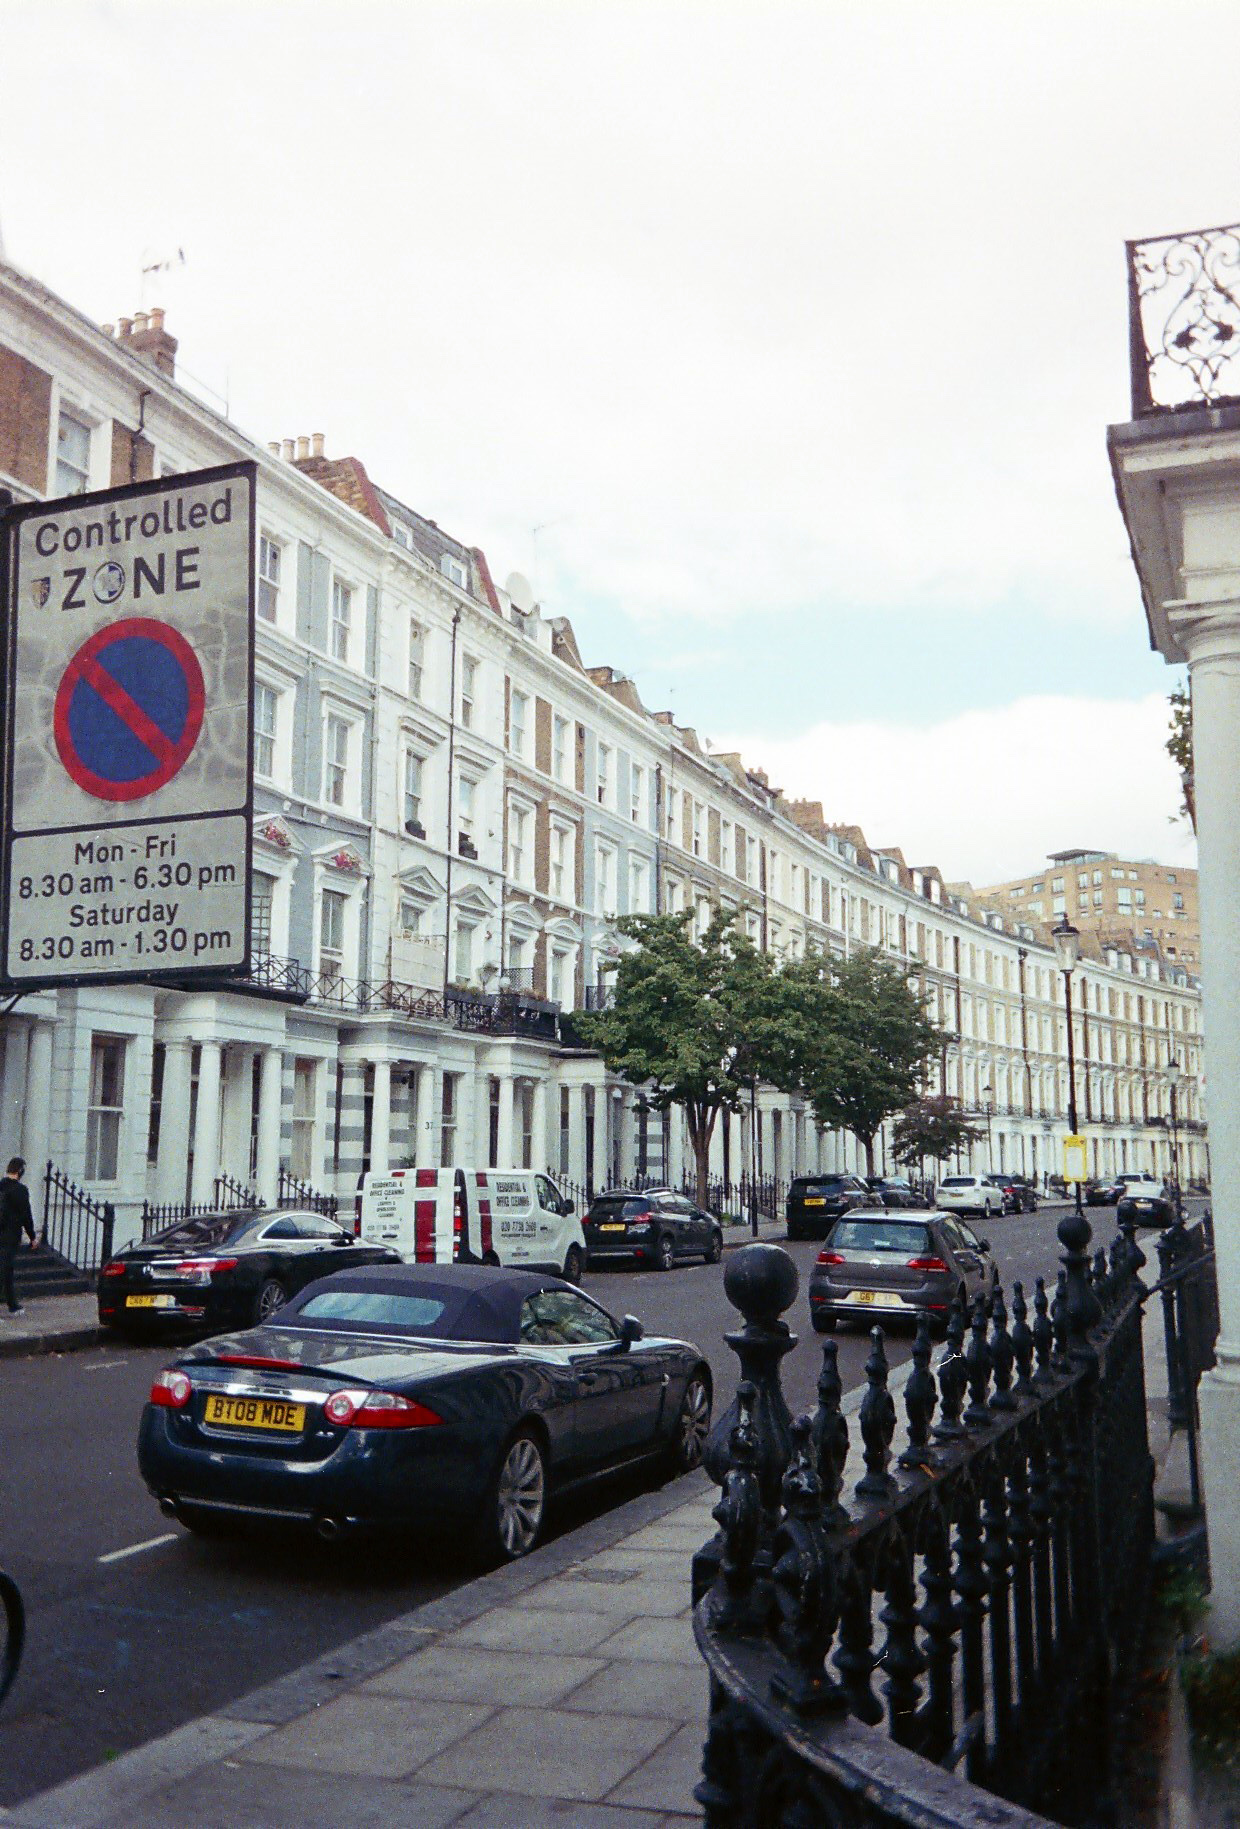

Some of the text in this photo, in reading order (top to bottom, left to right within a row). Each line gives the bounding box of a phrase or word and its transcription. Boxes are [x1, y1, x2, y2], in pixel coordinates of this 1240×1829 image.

[36, 488, 231, 557] Controlled
[75, 841, 124, 865] Mon
[146, 833, 176, 858] Fri
[19, 872, 74, 899] 8.30
[79, 875, 113, 894] am
[133, 862, 192, 890] 6.30
[198, 864, 235, 891] pm
[69, 899, 179, 927] Saturday
[20, 936, 74, 961] 8.30
[80, 938, 114, 957] am
[135, 928, 187, 954] 1.30
[194, 930, 231, 956] pm
[213, 1399, 298, 1426] BT08 MDE
